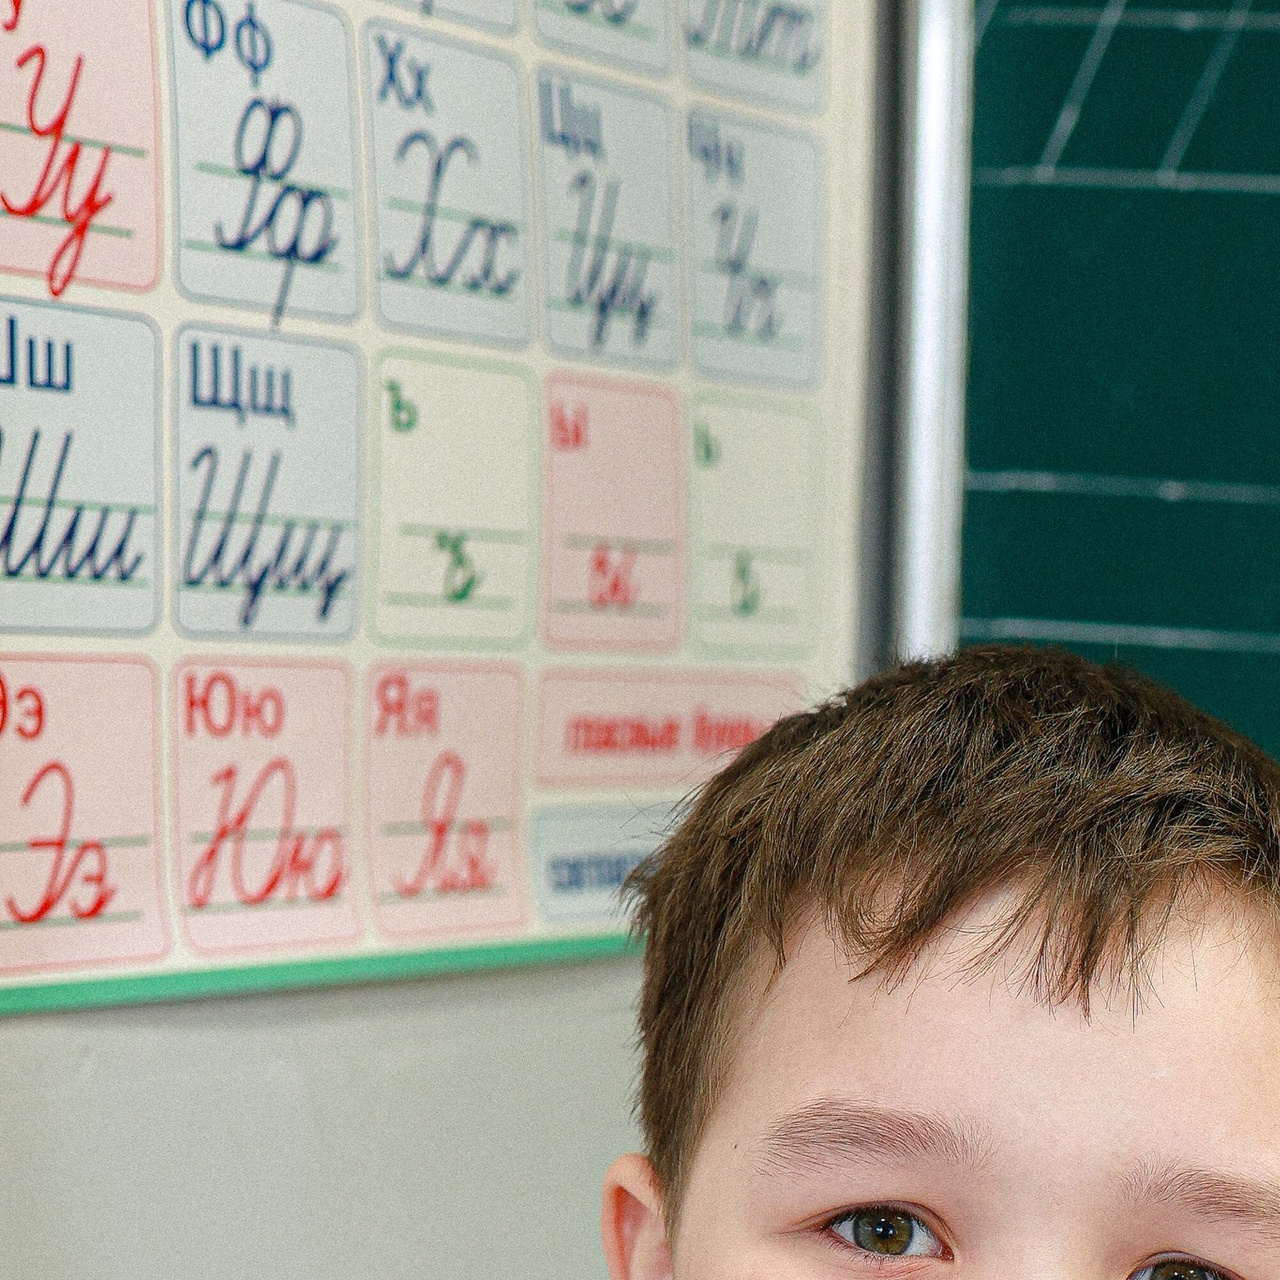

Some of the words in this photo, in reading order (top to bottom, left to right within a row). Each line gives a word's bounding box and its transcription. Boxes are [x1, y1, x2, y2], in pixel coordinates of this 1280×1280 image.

[191, 342, 295, 430] Щщ
[185, 672, 285, 738] Юю
[375, 673, 441, 738] Яя
